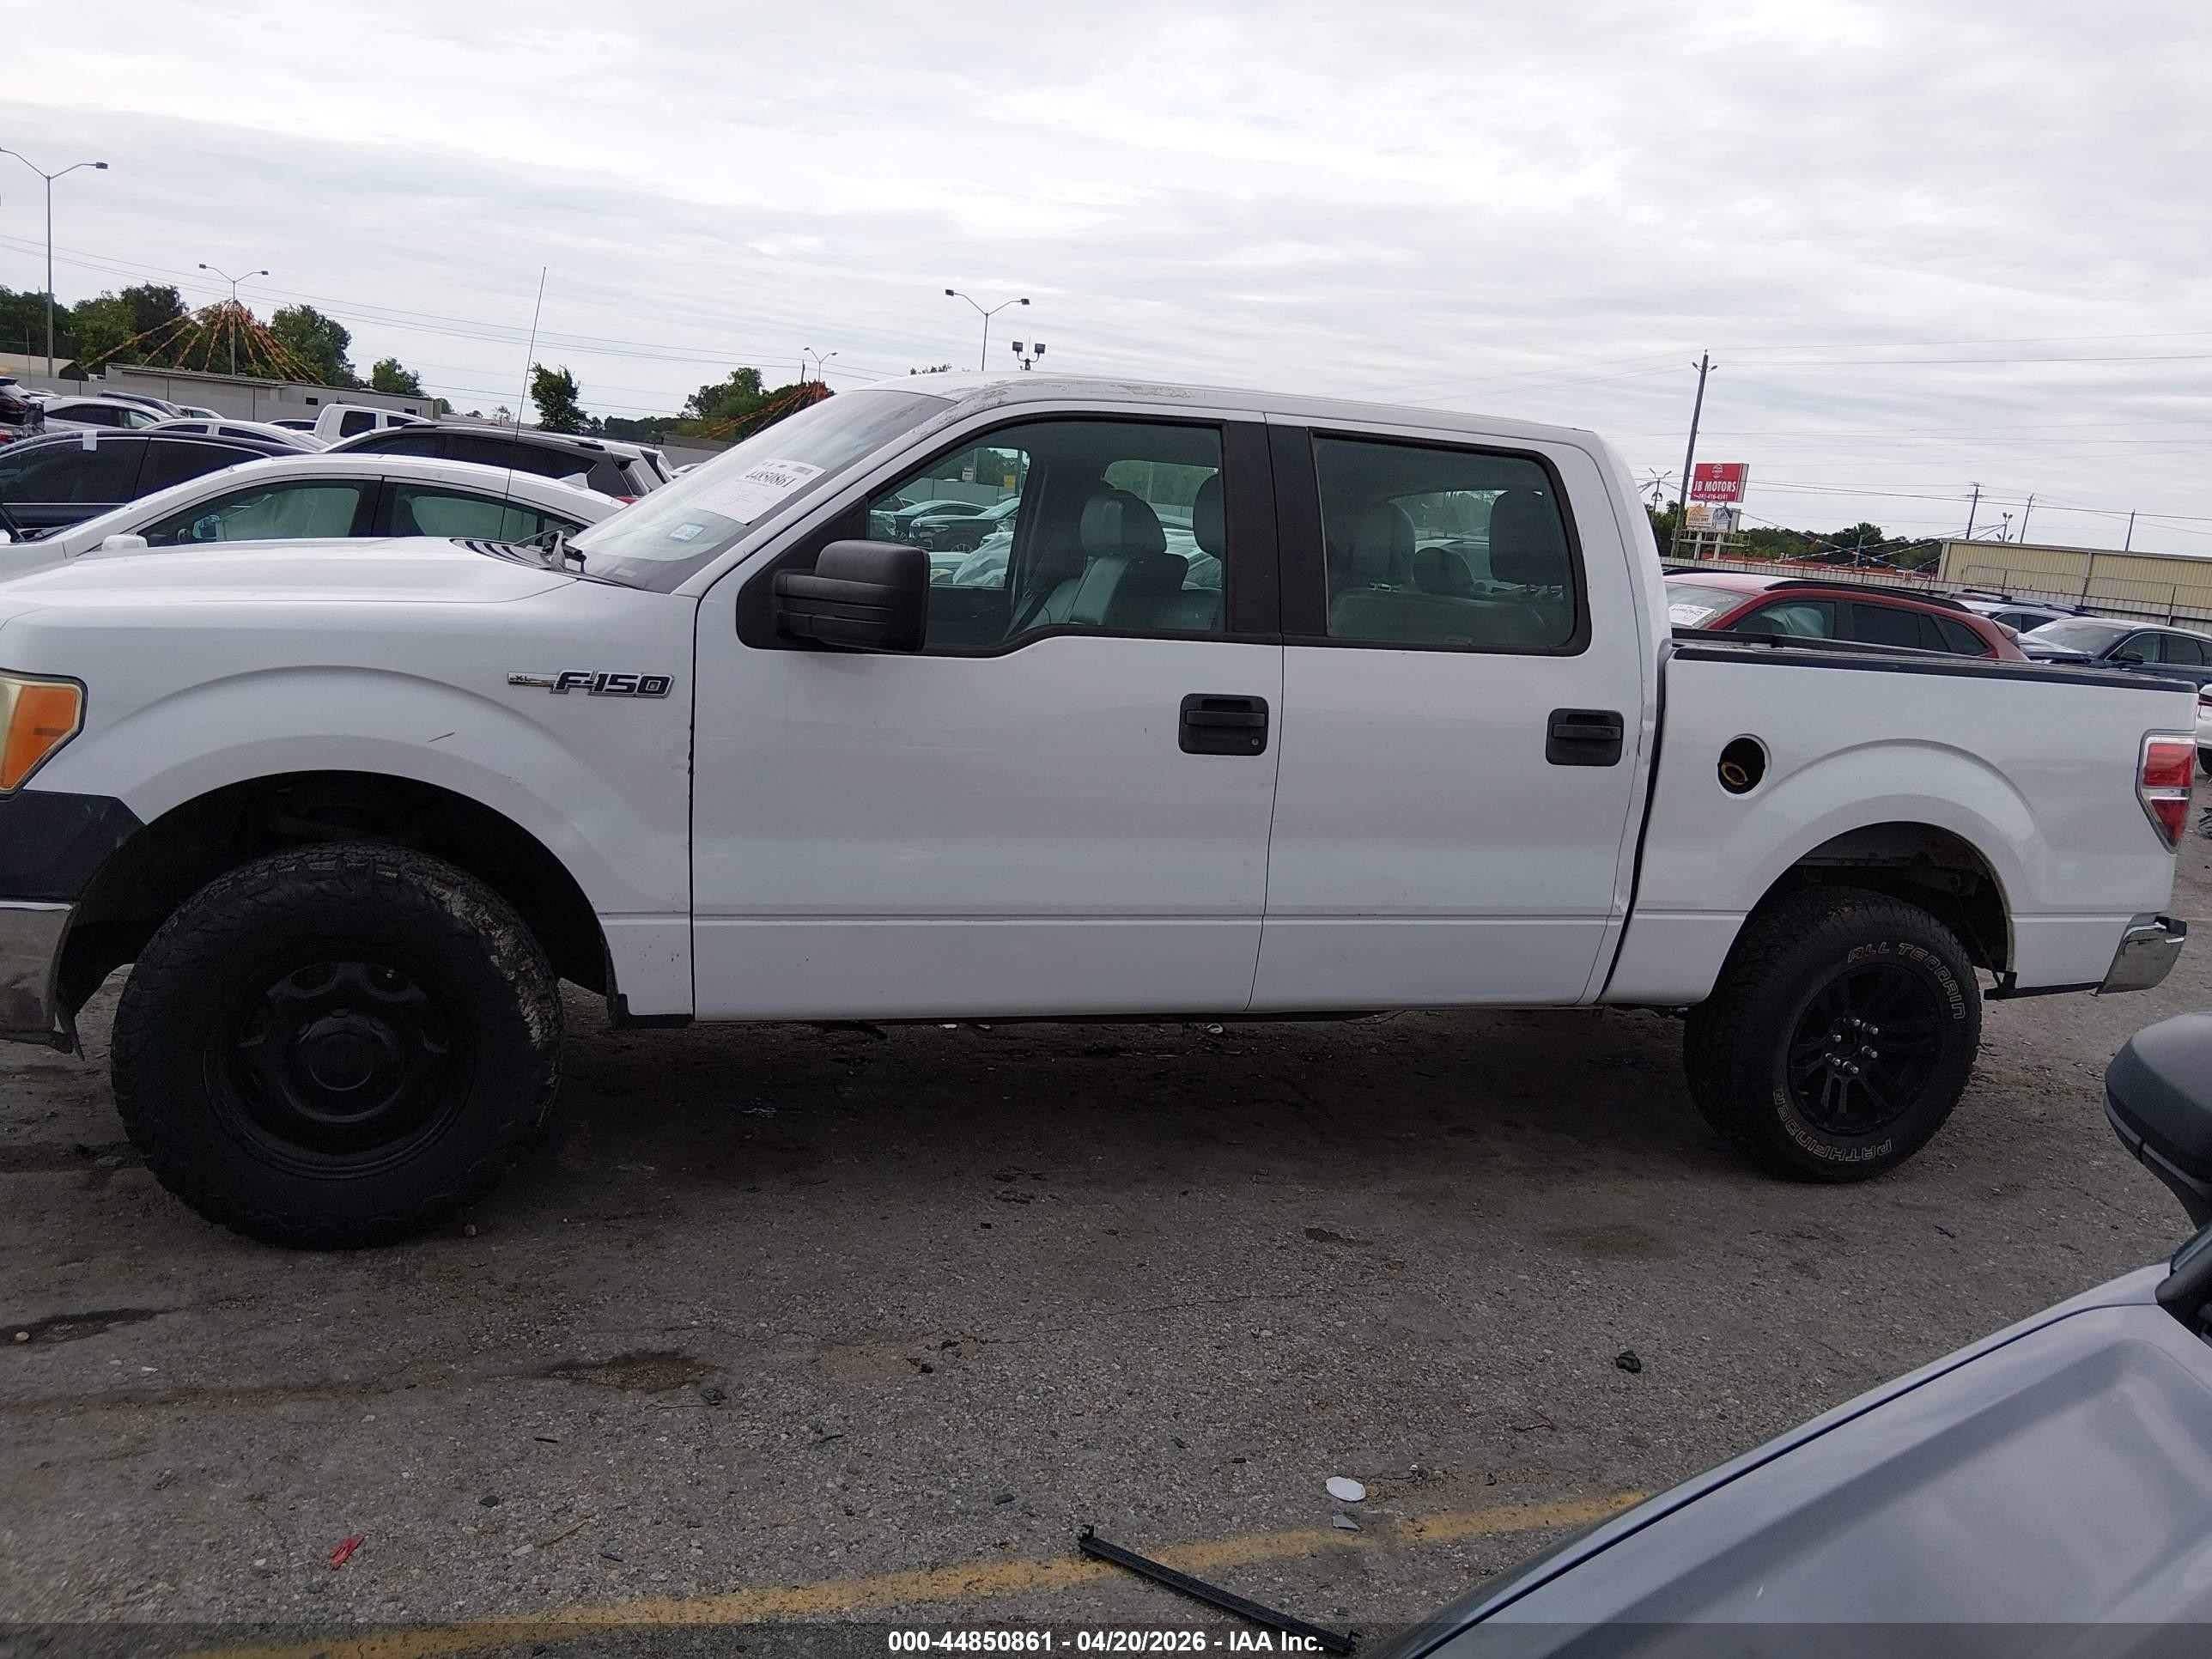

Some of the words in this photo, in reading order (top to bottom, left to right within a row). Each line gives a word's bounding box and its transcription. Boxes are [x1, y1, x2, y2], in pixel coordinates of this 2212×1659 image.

[1693, 481, 1703, 492] JB
[1705, 481, 1736, 492] MOTORS
[551, 668, 675, 698] F-150
[1848, 942, 1890, 963] ALL
[1898, 942, 1966, 1020] TERRAIN
[1772, 1088, 1893, 1162] PATHFINDER
